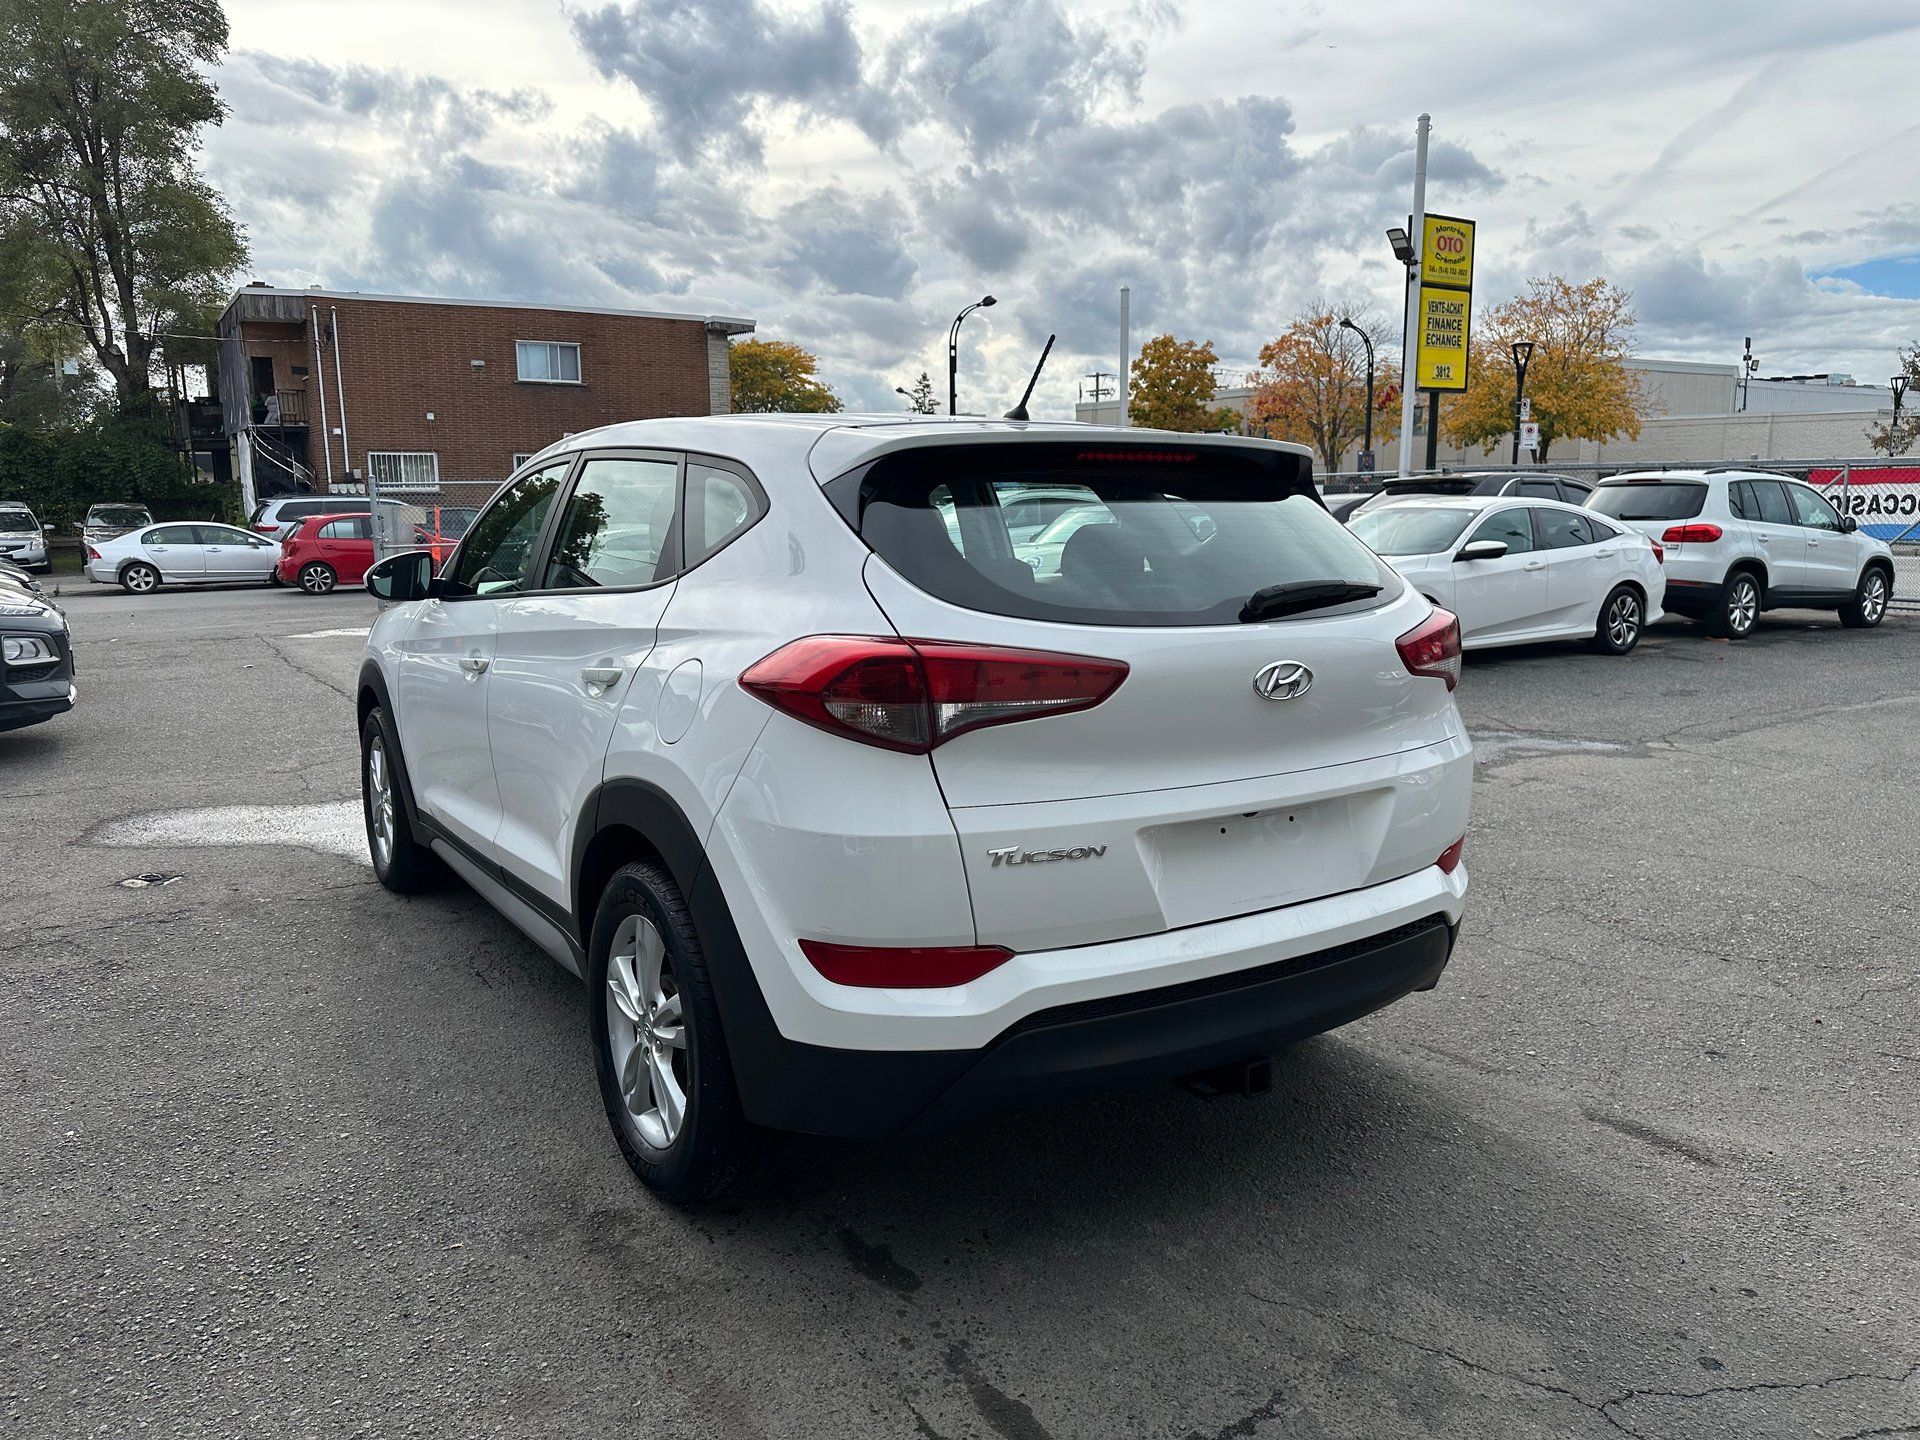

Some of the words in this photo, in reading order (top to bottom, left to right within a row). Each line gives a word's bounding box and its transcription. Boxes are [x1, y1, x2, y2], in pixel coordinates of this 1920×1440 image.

[1436, 225, 1466, 238] Montréal
[1437, 236, 1463, 253] OTO
[1428, 301, 1464, 314] VENTE-ACHAT
[1427, 317, 1462, 331] FINANCE
[1426, 333, 1462, 347] ECHANGE
[1436, 366, 1450, 378] 3812
